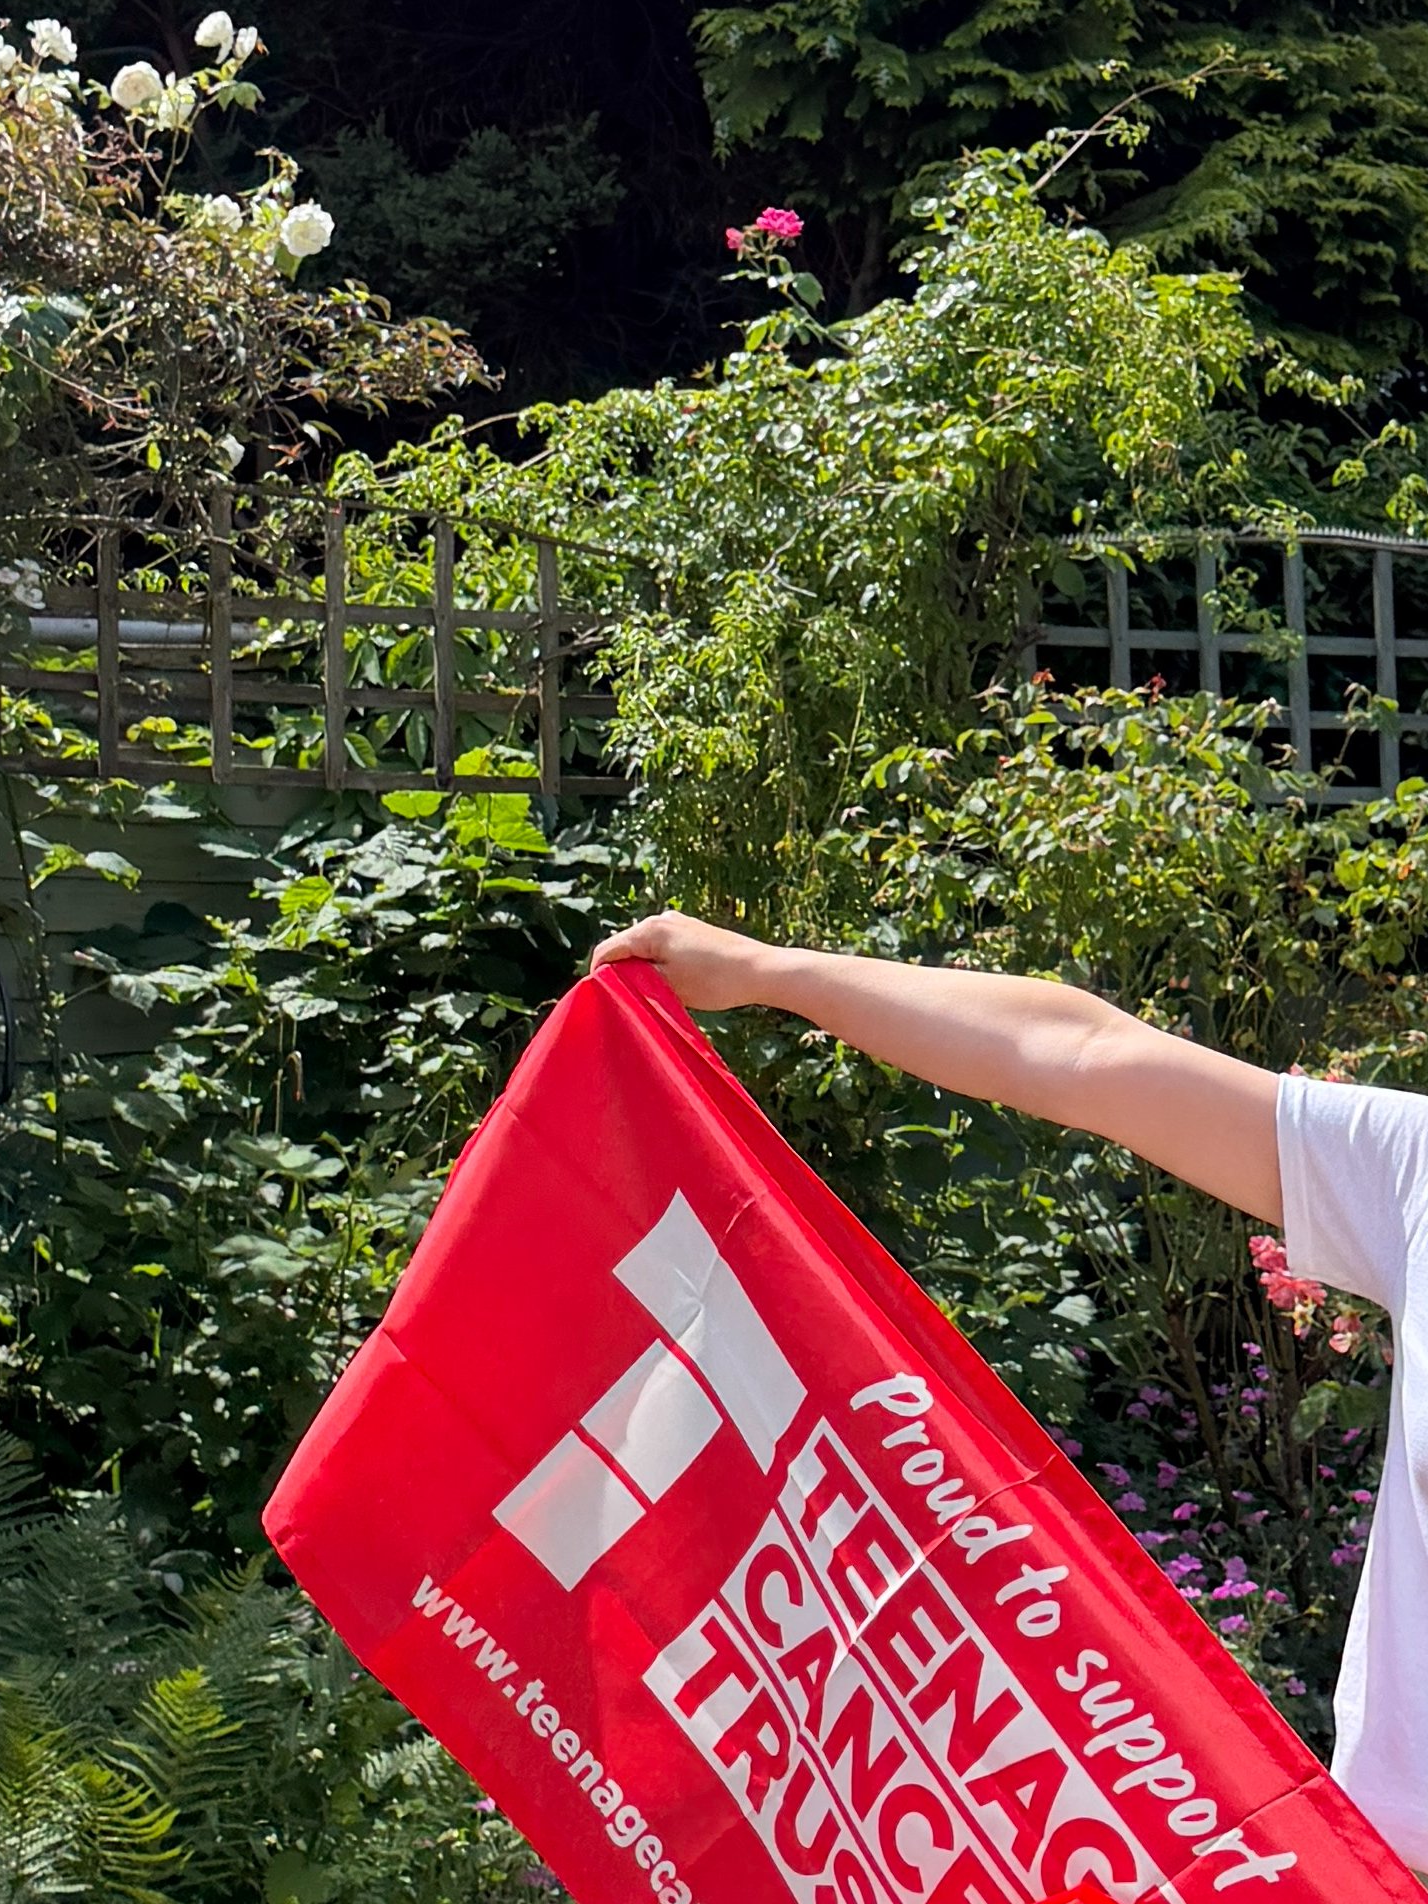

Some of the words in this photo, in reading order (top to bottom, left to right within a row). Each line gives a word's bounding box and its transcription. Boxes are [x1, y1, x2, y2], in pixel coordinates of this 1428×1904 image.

[799, 1432, 1138, 1898] TEENAG
[850, 1372, 1033, 1565] Proud
[996, 1563, 1069, 1638] to
[1056, 1649, 1298, 1892] support
